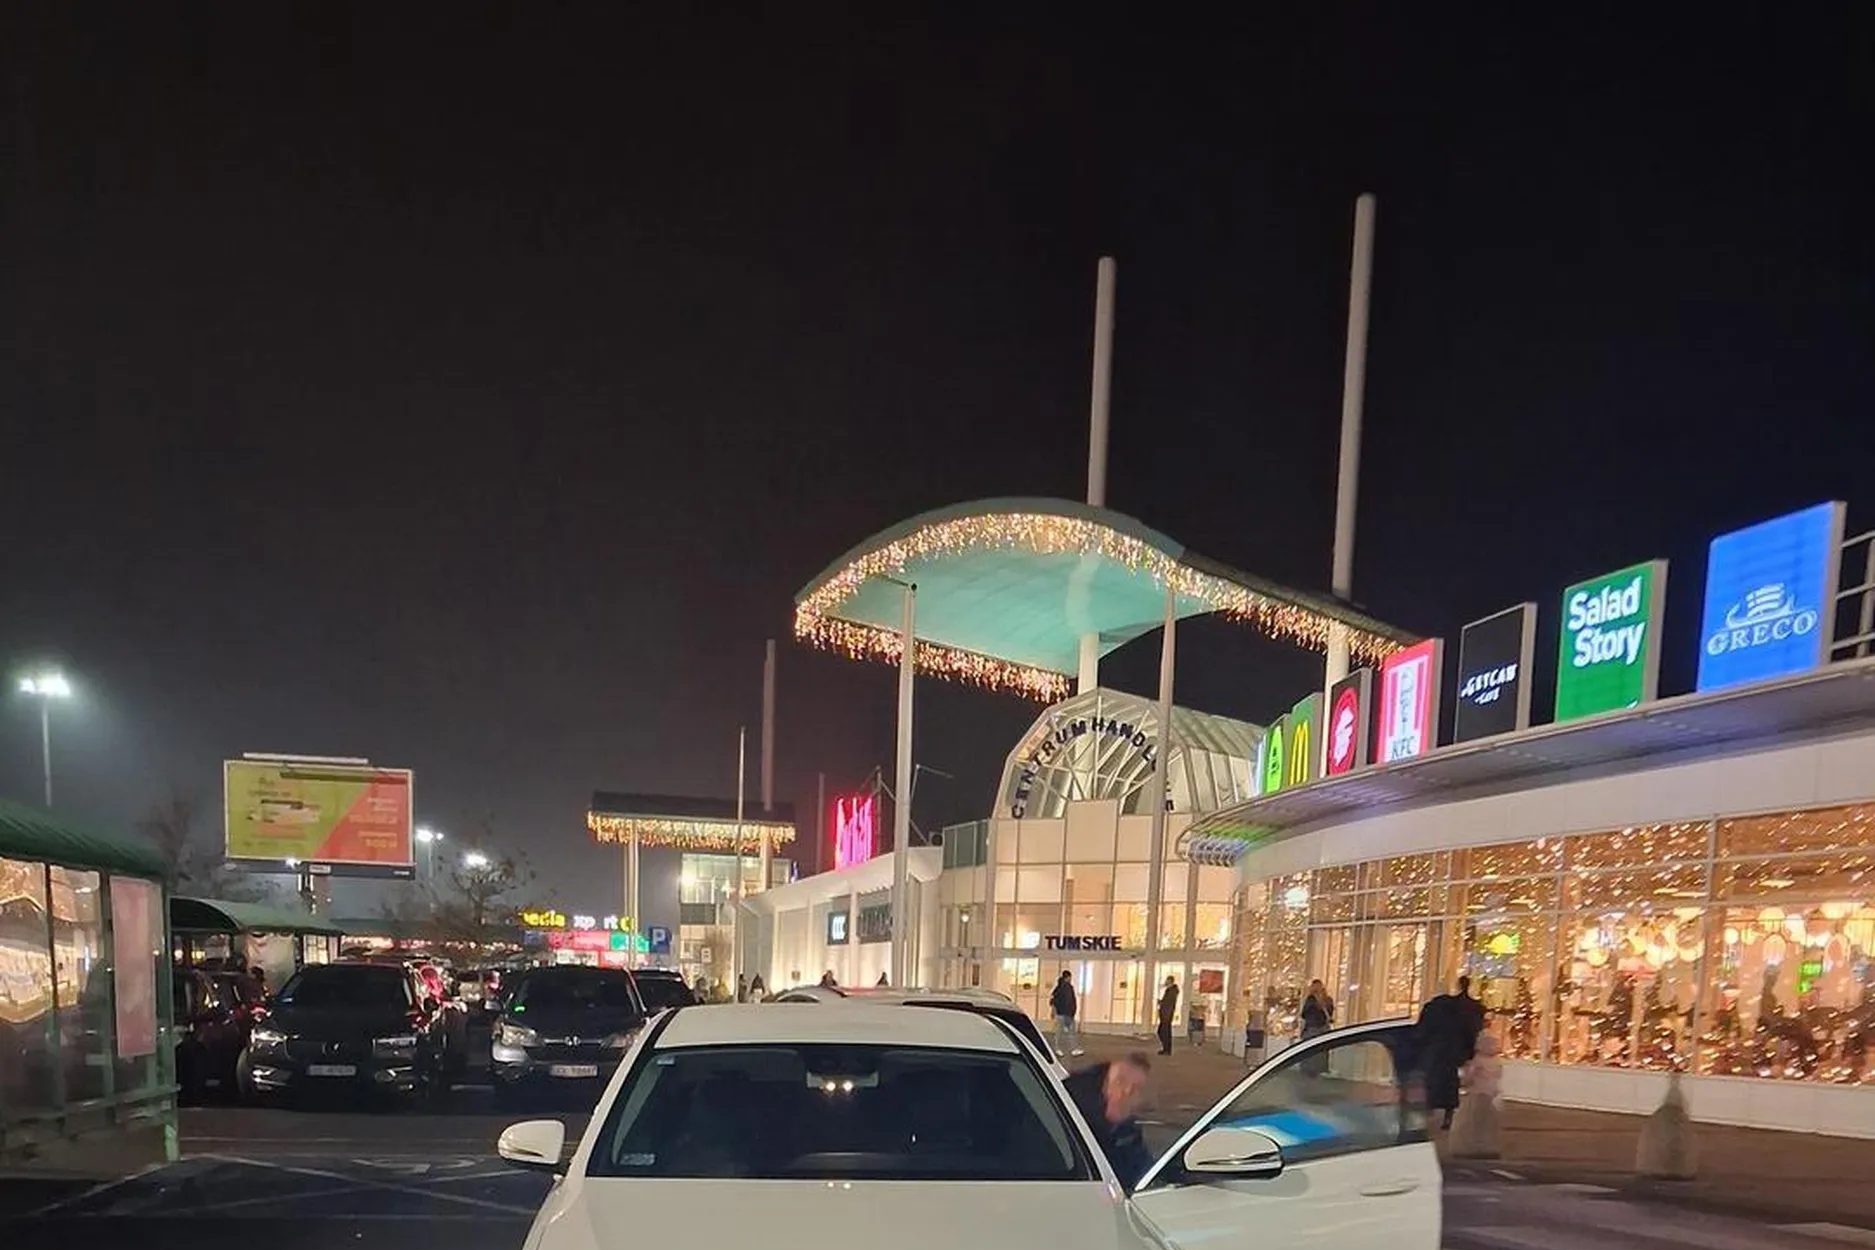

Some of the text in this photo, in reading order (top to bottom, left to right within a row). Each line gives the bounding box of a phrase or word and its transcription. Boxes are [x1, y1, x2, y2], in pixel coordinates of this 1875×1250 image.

[1567, 575, 1642, 631] Salad
[1573, 621, 1645, 668] Story
[1707, 610, 1818, 656] GRECO
[1012, 720, 1087, 819] CENTRUM
[1045, 935, 1122, 950] TUMSKIE
